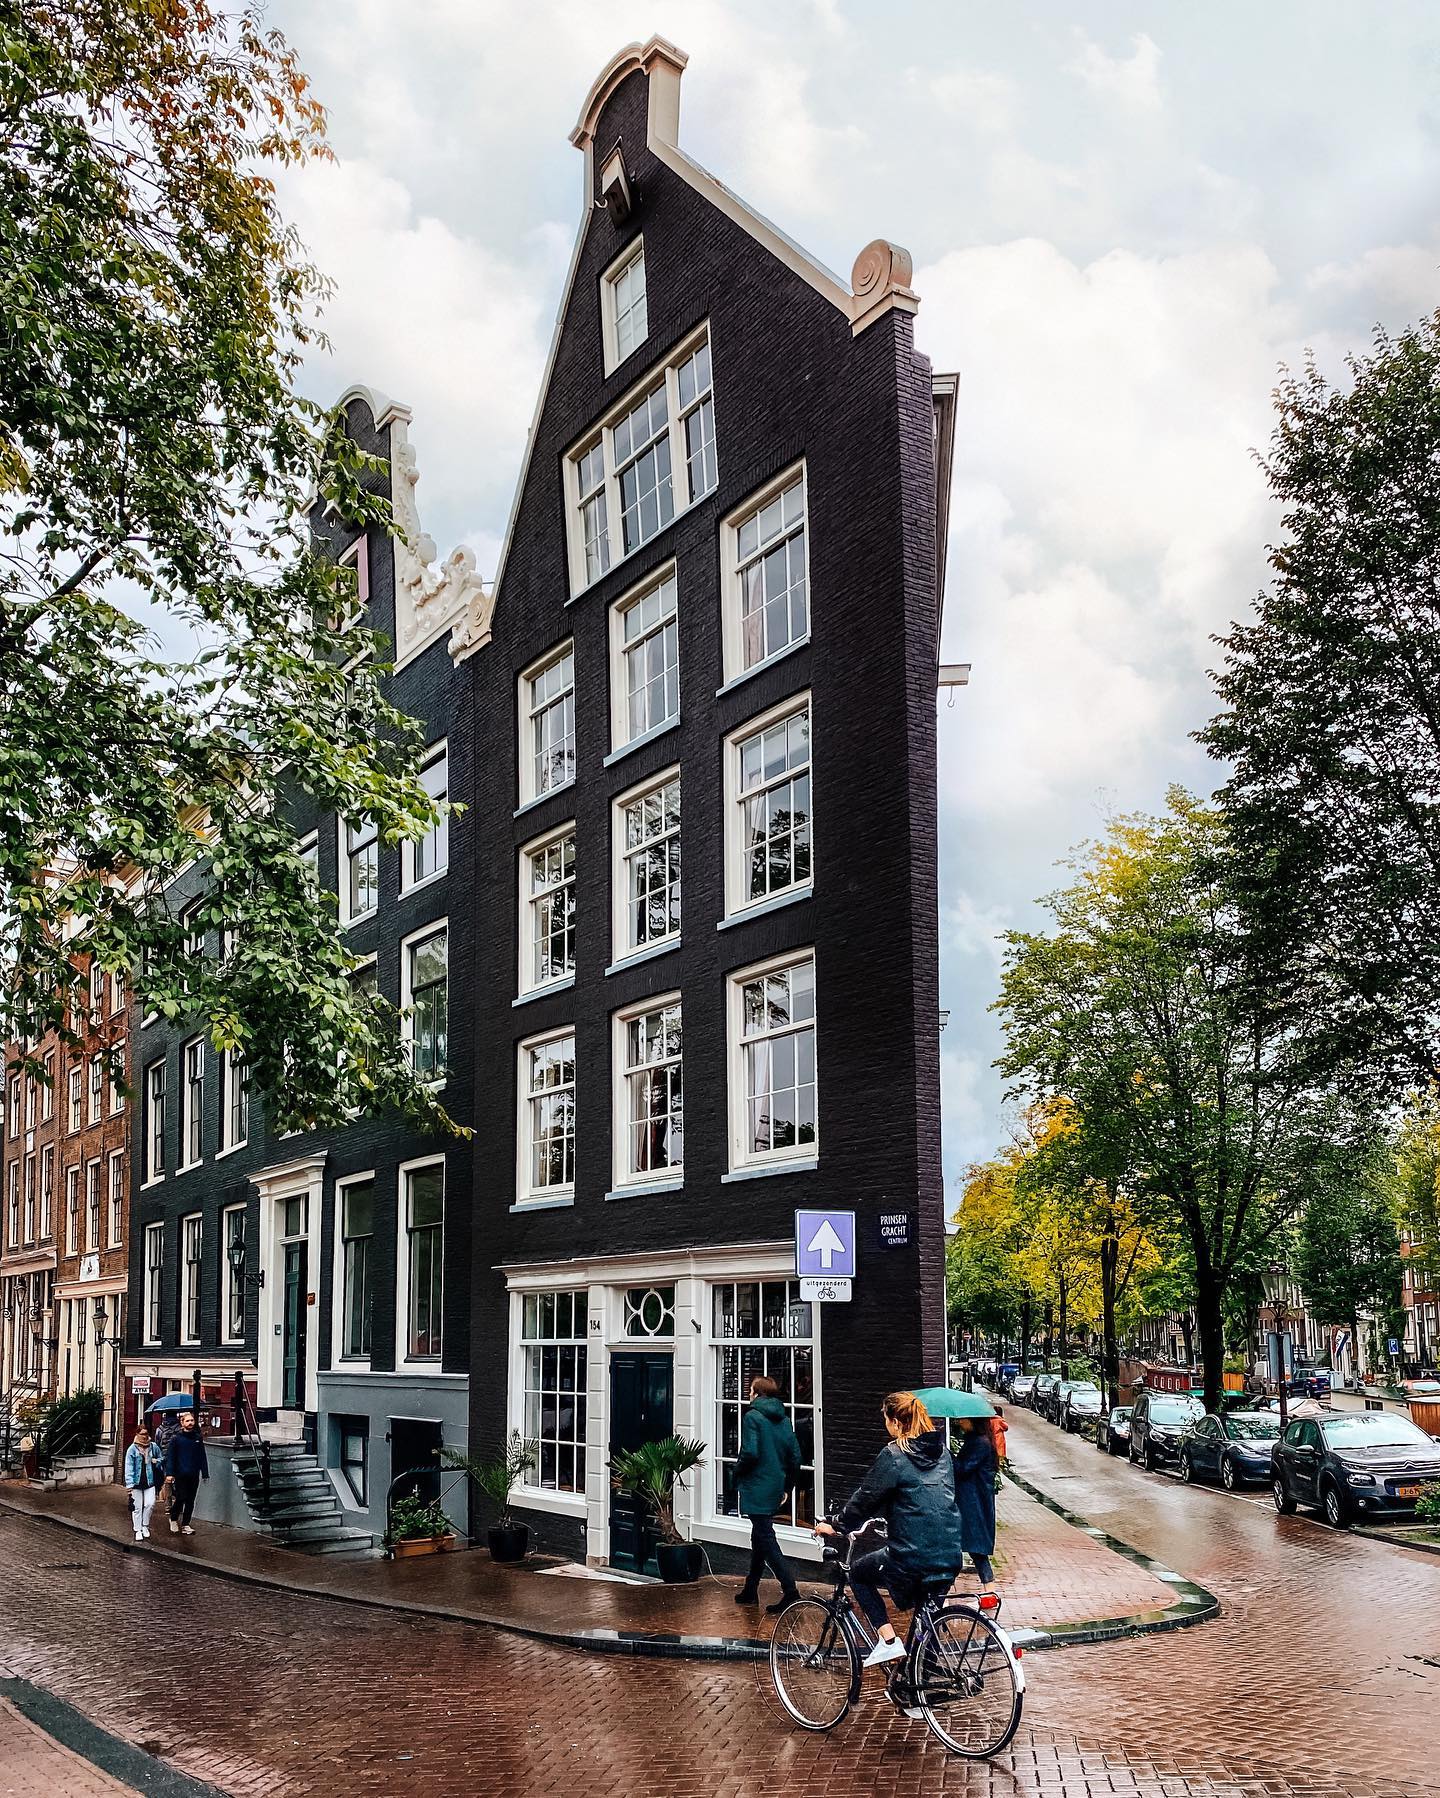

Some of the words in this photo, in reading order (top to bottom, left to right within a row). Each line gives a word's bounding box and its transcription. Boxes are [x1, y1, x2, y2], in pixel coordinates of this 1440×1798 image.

[880, 1214, 907, 1225] PRINSEN
[881, 1225, 907, 1237] GRACHT
[590, 1320, 601, 1331] 154
